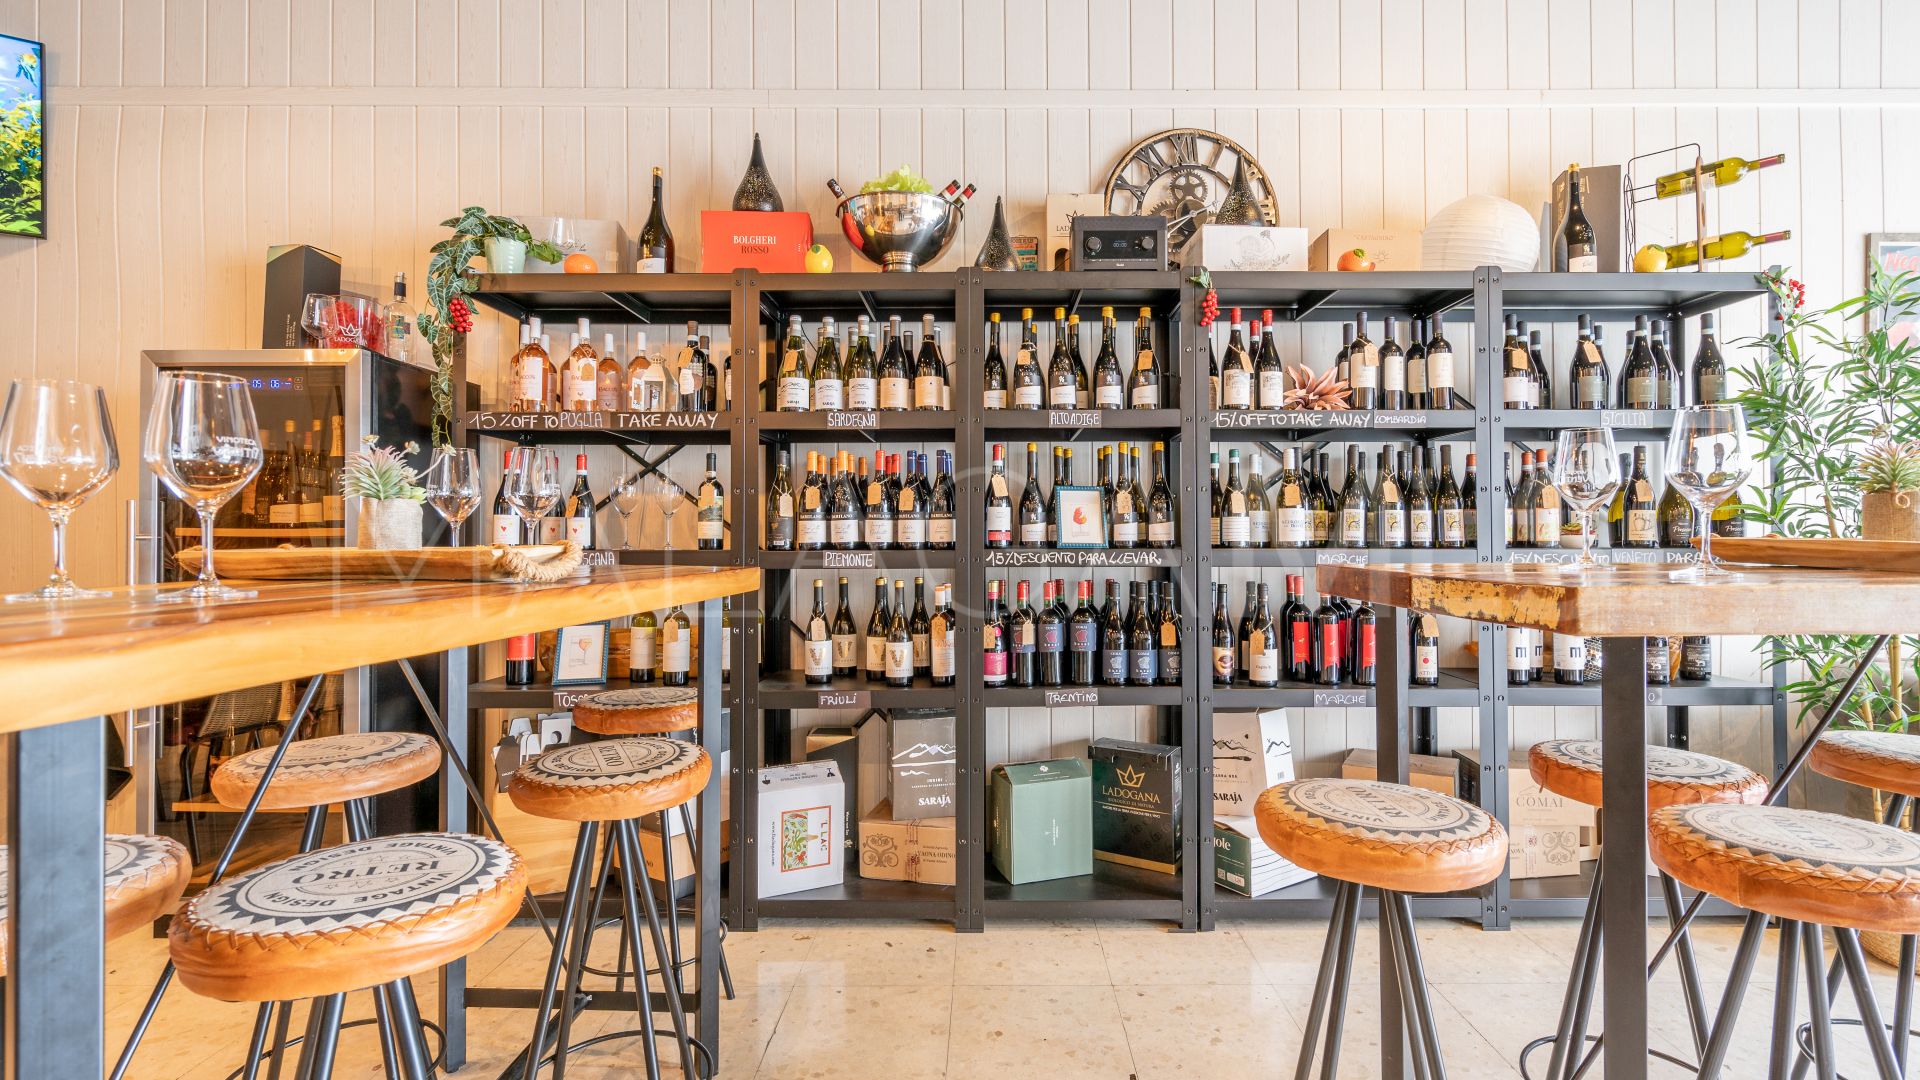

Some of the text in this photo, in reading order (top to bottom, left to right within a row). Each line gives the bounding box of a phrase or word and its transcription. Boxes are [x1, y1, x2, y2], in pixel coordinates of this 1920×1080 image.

[733, 235, 777, 245] BOLGHERI
[741, 245, 769, 254] ROSSO
[542, 414, 559, 429] TO
[559, 412, 604, 428] PUGLIA
[617, 413, 719, 430] TAKE AWAY
[828, 412, 877, 428] SARDEGNA
[1330, 413, 1371, 428] AWAY
[1602, 412, 1647, 426] SICILIA
[825, 553, 873, 567] PIEMONTE
[1078, 553, 1107, 565] PARA
[1108, 552, 1162, 565] LLEVAR
[1318, 554, 1368, 565] MARCHE
[1615, 552, 1656, 563] VENETO
[1315, 693, 1366, 705] MARCHE
[1102, 785, 1161, 804] LADOGANA
[291, 859, 441, 885] RETRO
[352, 870, 455, 905] VINTAGE
[263, 889, 337, 909] DESIGN
